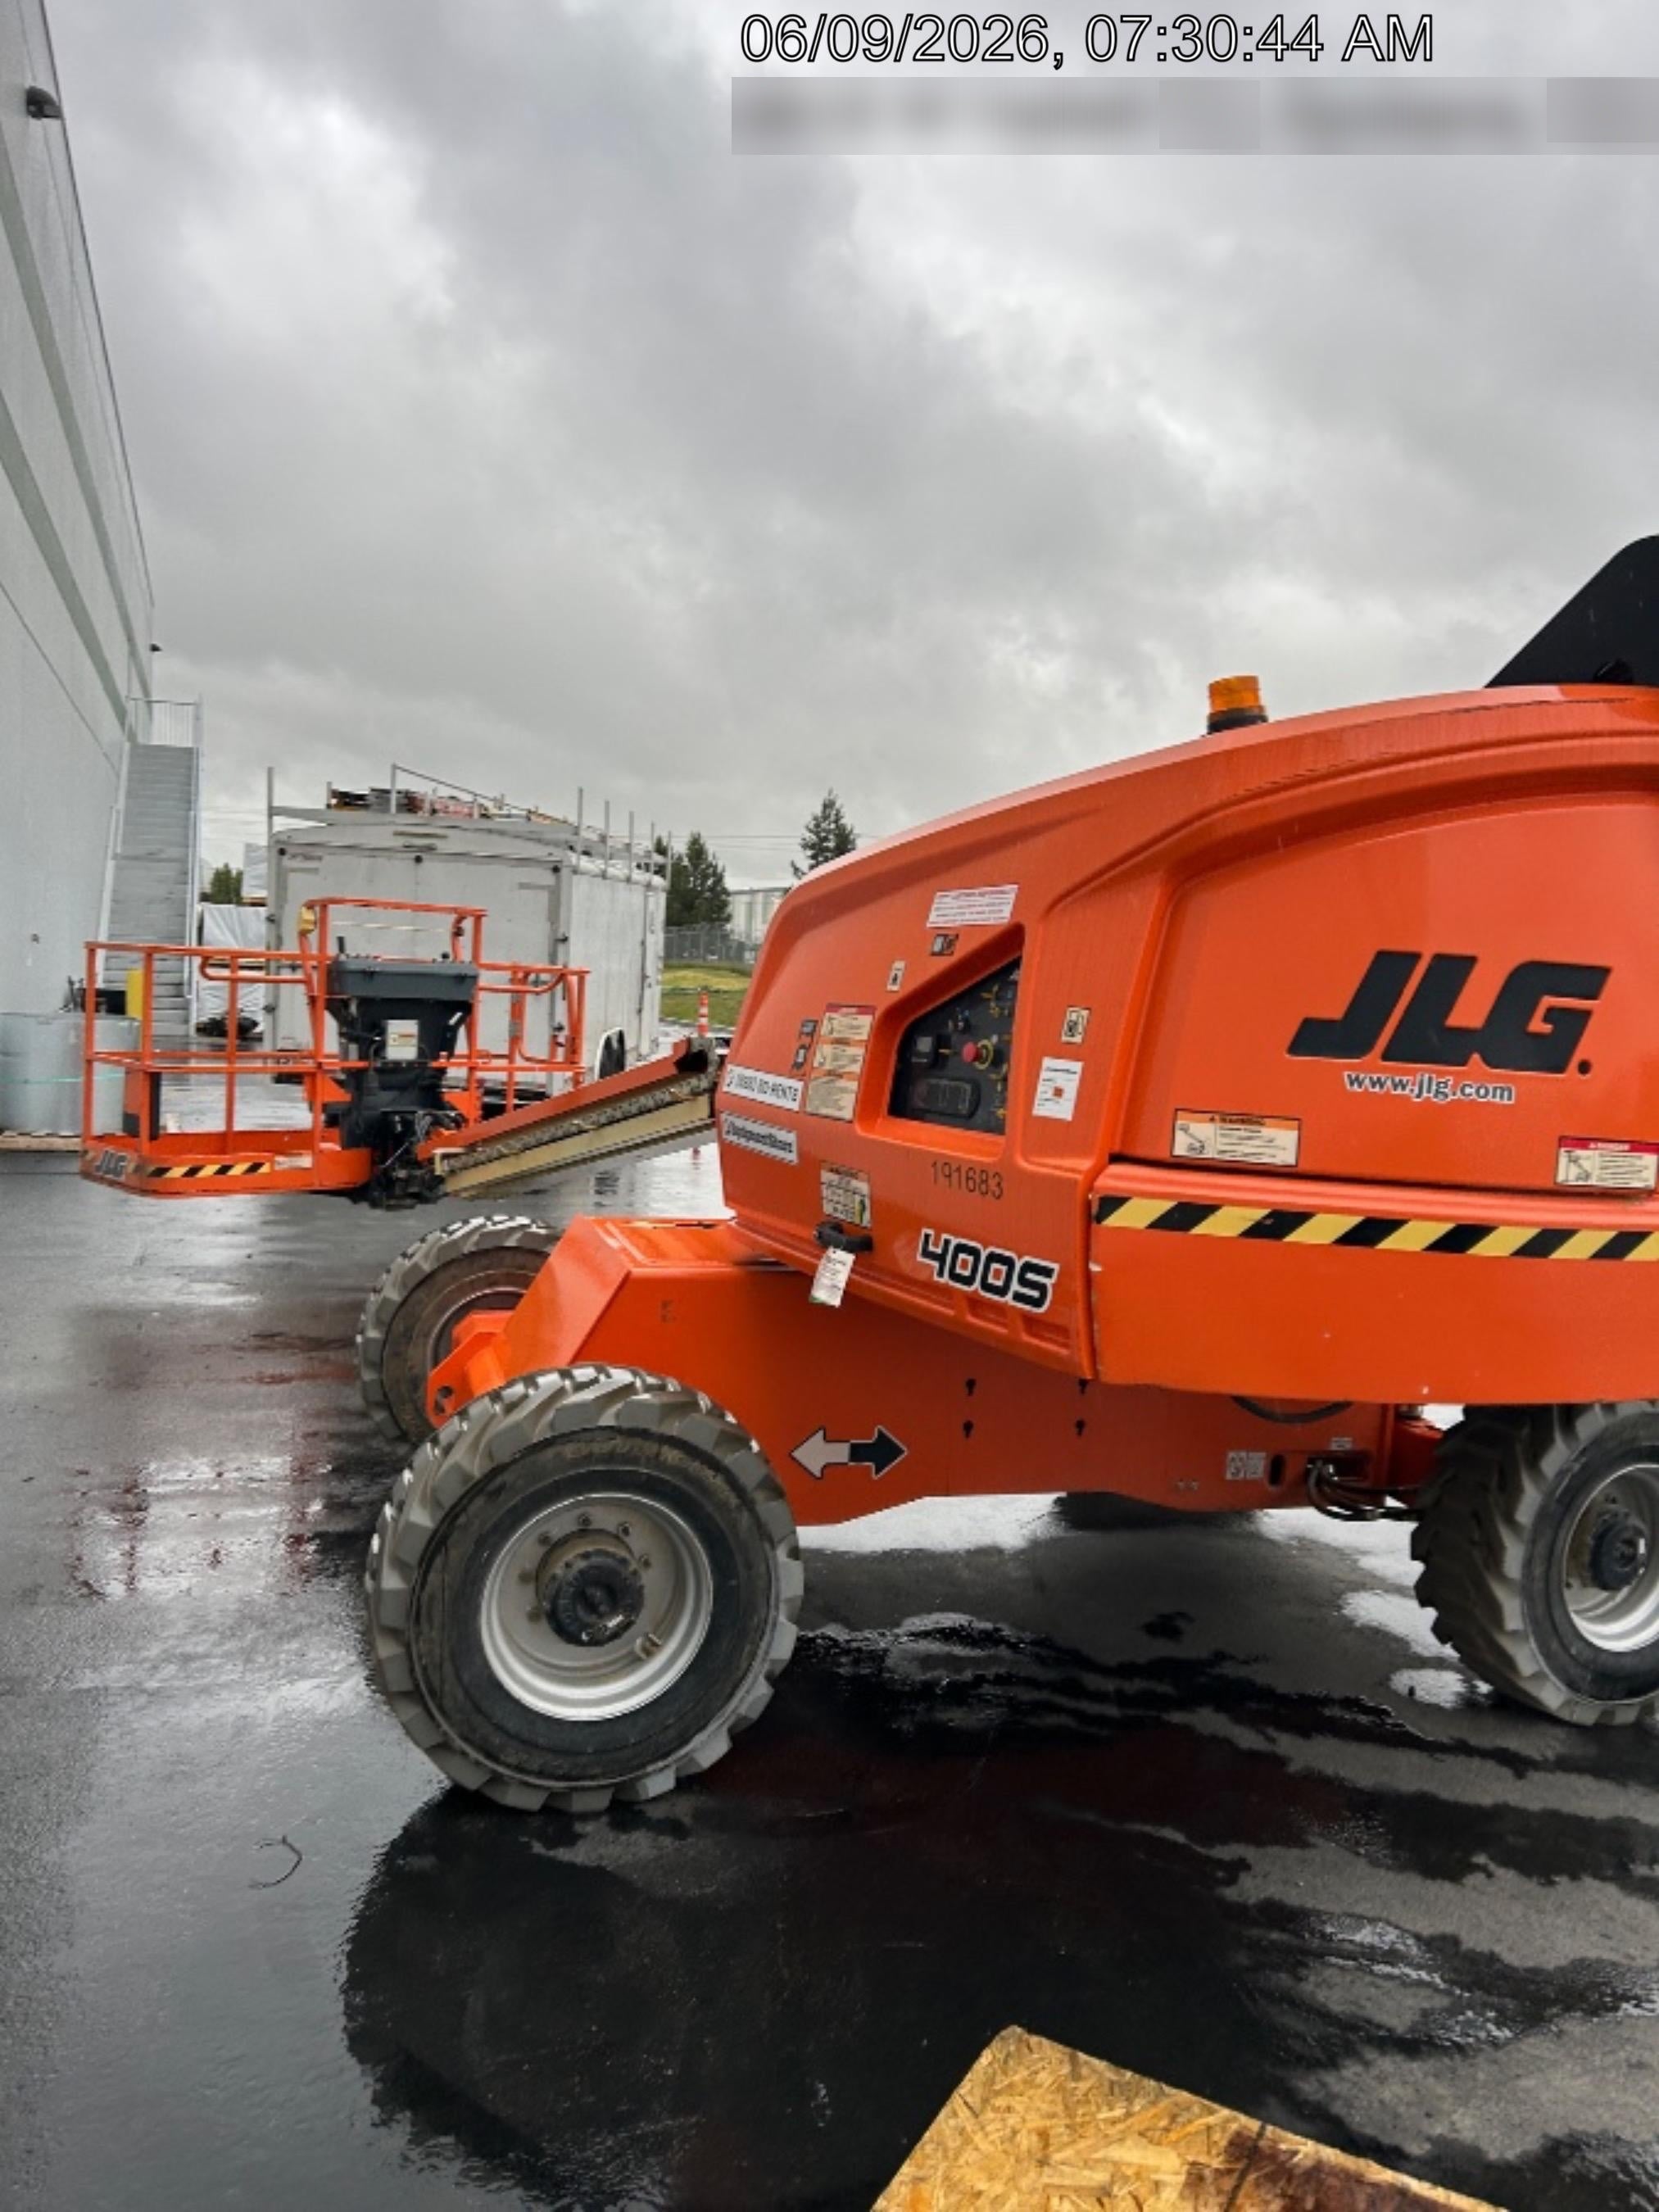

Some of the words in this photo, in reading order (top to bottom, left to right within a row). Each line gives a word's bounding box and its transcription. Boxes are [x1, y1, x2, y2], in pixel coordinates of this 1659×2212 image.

[1286, 950, 1612, 1075] JLG
[1344, 1071, 1516, 1104] www.jlg.com
[94, 1149, 128, 1178] JLG
[931, 1161, 1004, 1200] 191683
[918, 1229, 1059, 1312] 400S
